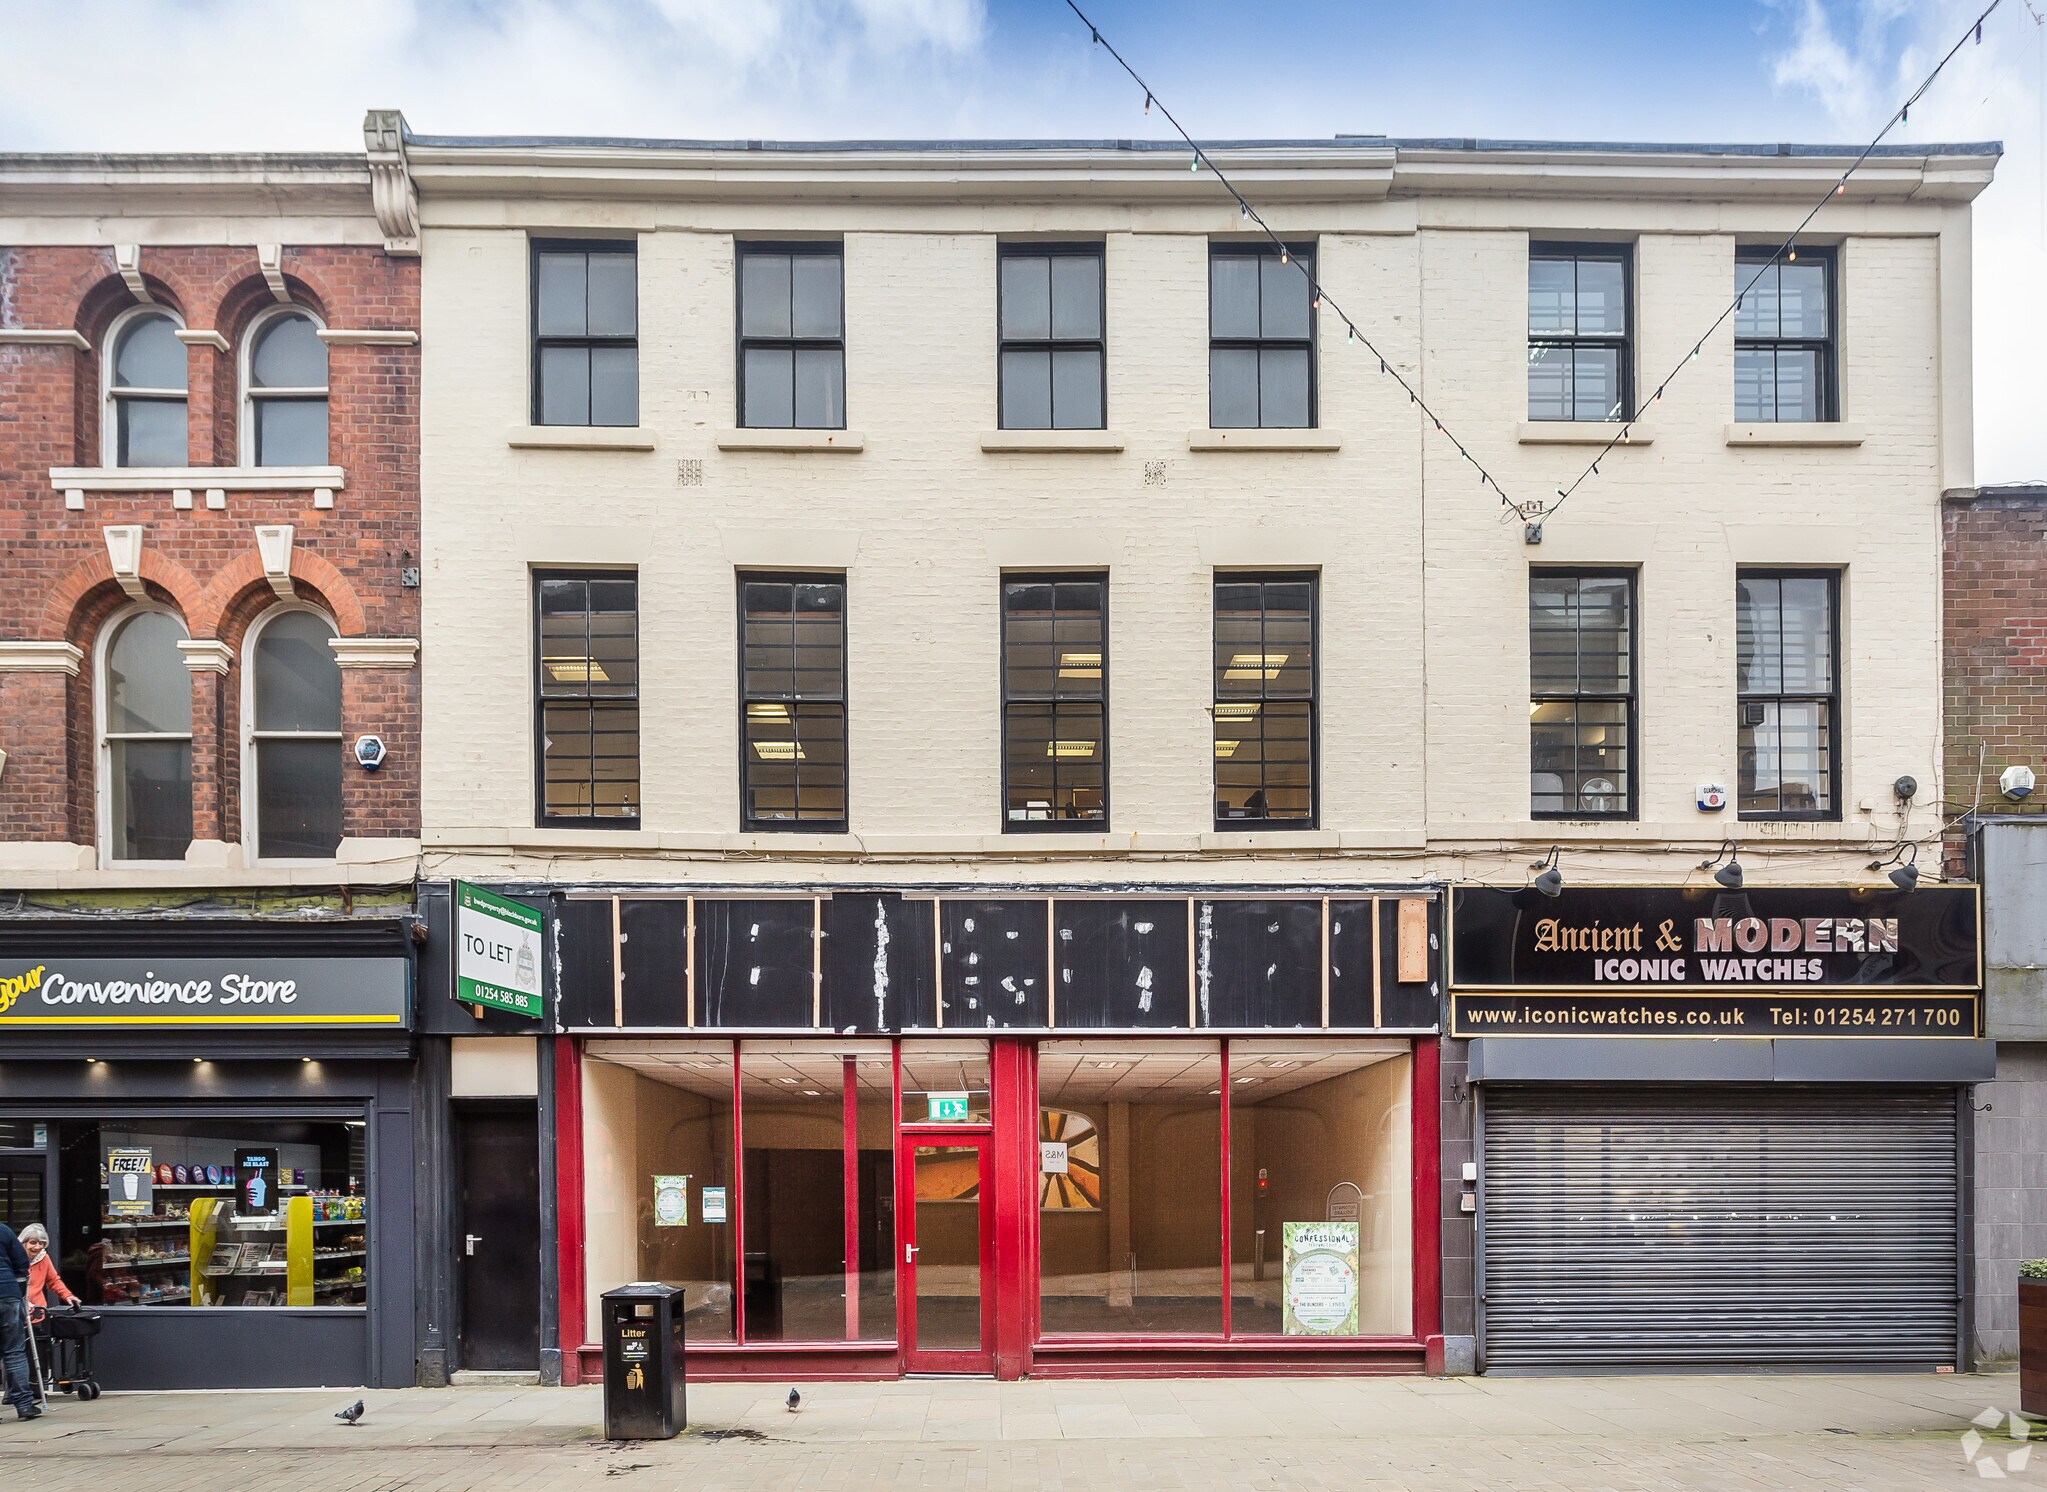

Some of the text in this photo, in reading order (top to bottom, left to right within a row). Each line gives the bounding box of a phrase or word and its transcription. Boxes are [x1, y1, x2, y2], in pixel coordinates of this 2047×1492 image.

[1534, 918, 1899, 953] Ancient & MODERN
[464, 933, 513, 964] TO LET
[1594, 958, 1823, 981] ICONIC WATCHES
[41, 971, 213, 1005] Convenience
[219, 974, 298, 1004] Store
[475, 984, 529, 1008] 01254 585 885
[1467, 1006, 1961, 1026] www.iconicwatches.co.uk Tel: 01254 271 700
[112, 1158, 149, 1172] FREE!!
[1294, 1234, 1350, 1243] CONFESSIONAL
[621, 1329, 646, 1338] Litter
